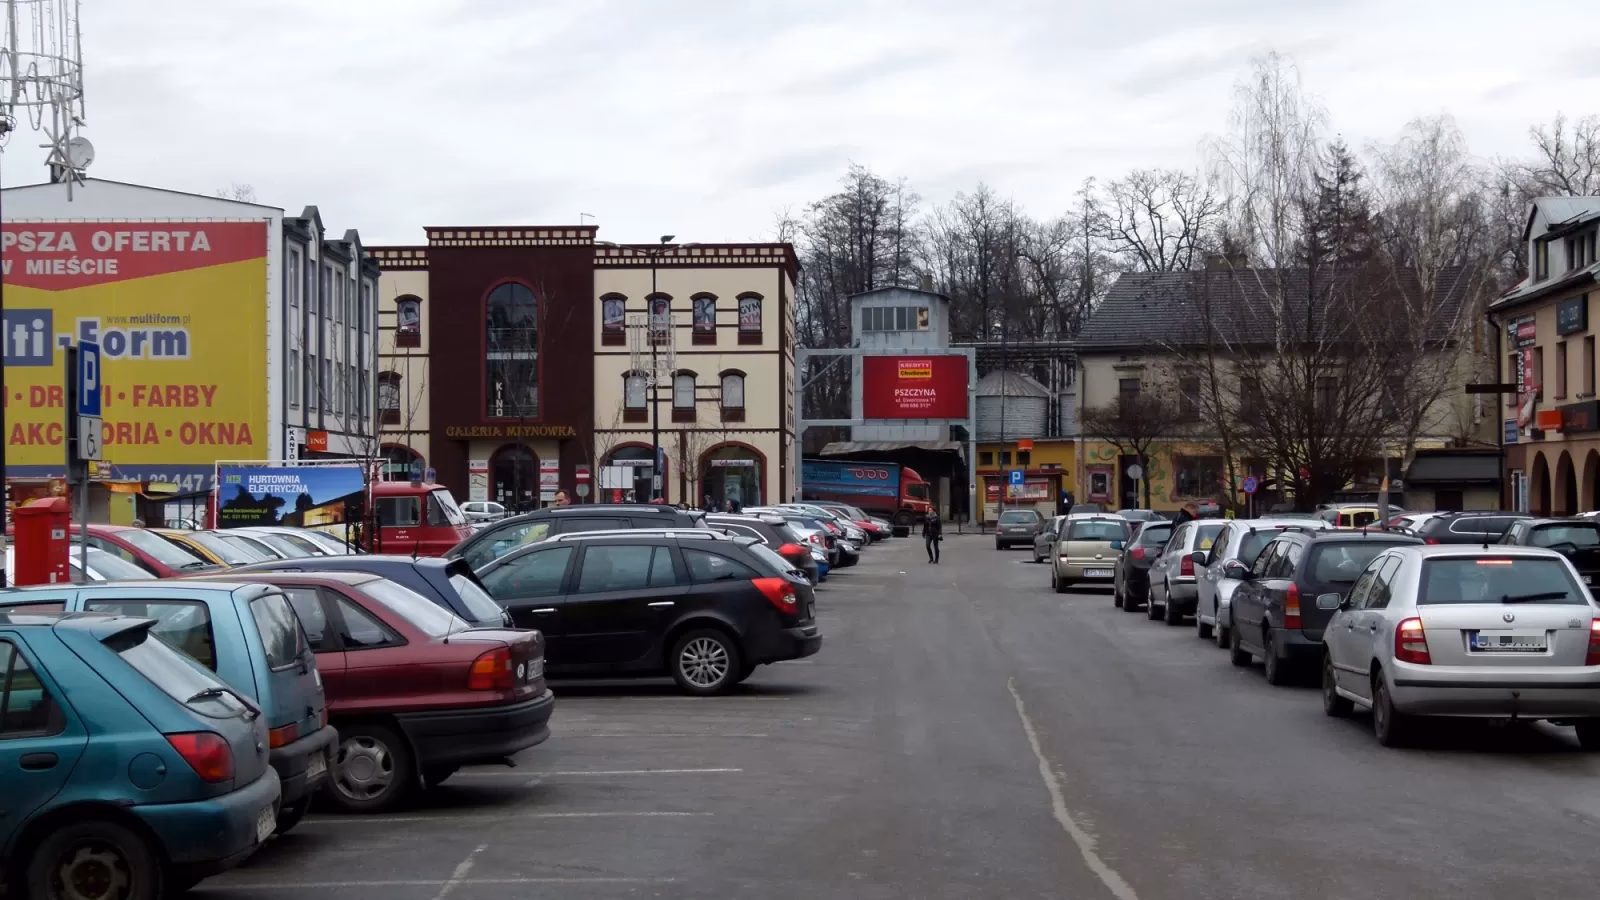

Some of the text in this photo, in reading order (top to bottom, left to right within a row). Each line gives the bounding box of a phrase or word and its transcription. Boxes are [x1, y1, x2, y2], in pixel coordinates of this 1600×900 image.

[91, 231, 211, 252] OFERTA
[26, 255, 118, 275] MIEŚCIE
[739, 301, 760, 314] GYM
[106, 313, 191, 326] www.multiform.pl
[84, 350, 97, 407] P
[132, 384, 217, 408] FARBY
[495, 382, 503, 417] KINO
[179, 422, 253, 446] OKNA
[446, 426, 502, 437] GALERIA
[310, 437, 326, 445] ING
[249, 475, 301, 484] HURTOWNIA
[1012, 471, 1021, 483] P
[249, 484, 309, 493] ELEKTRYCZNA
